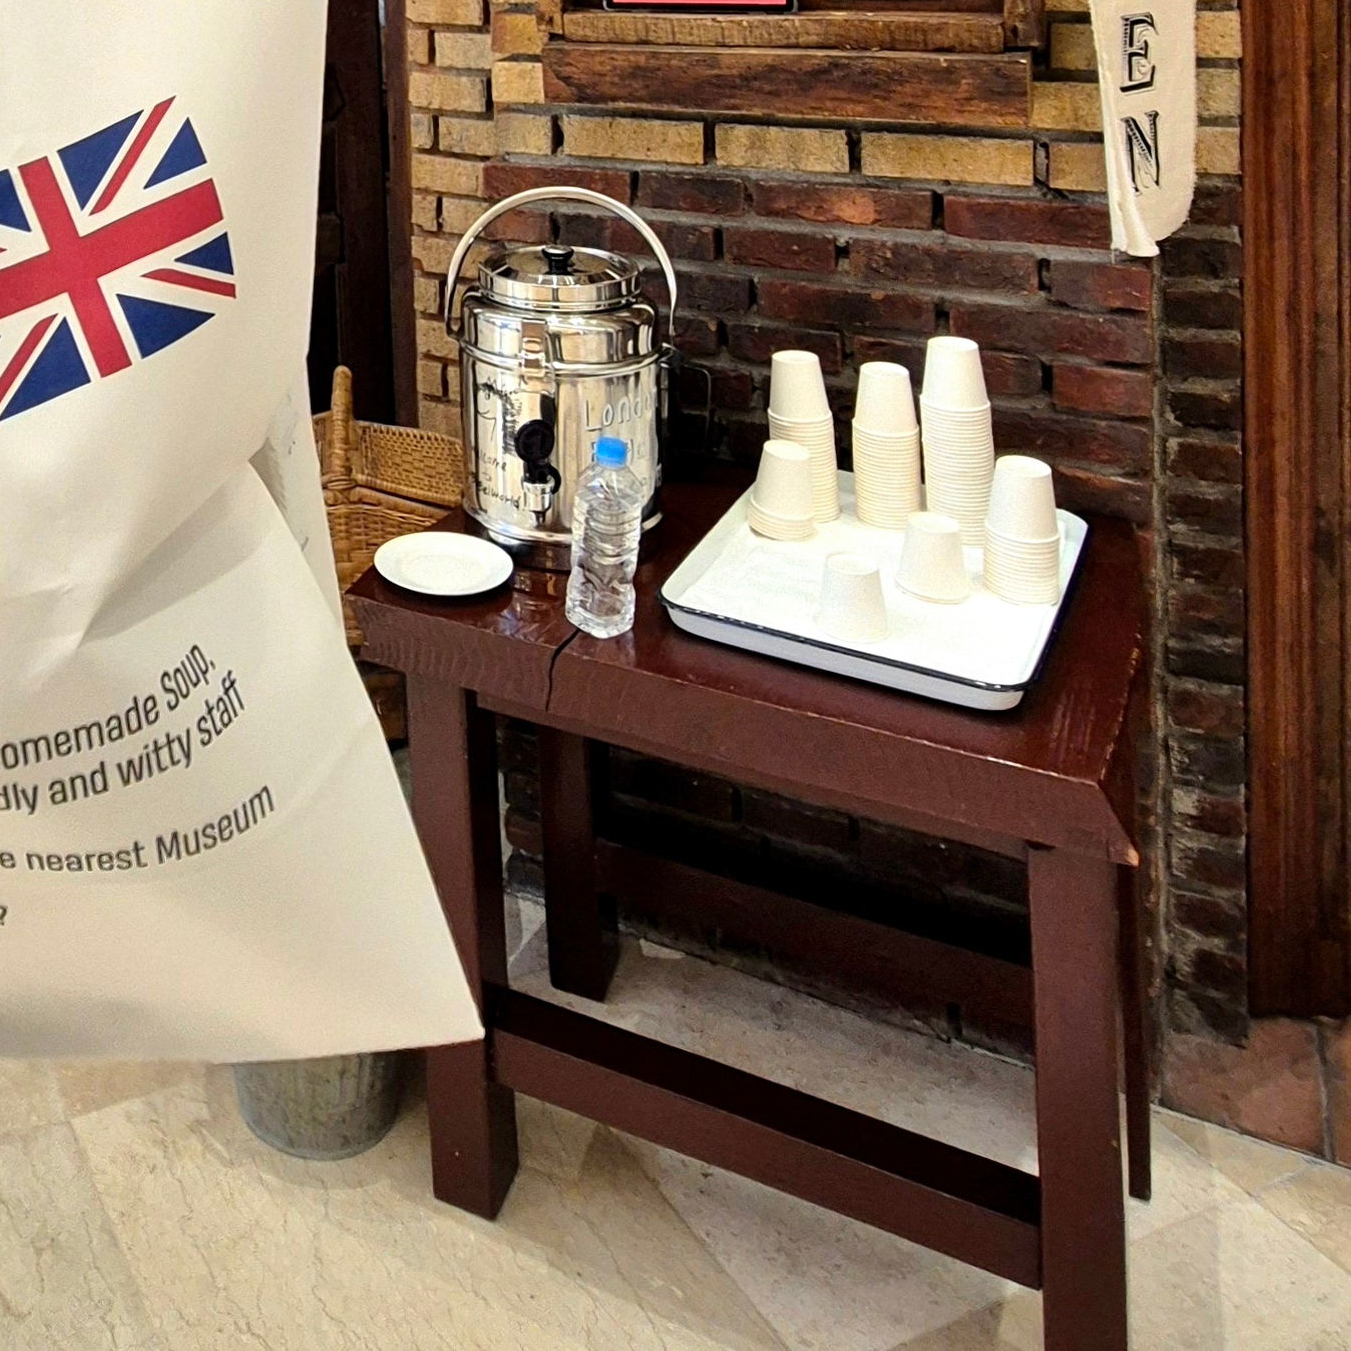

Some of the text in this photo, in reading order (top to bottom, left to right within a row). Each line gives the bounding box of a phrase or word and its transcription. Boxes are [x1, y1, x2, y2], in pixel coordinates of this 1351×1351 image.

[159, 644, 216, 711] Soup,
[49, 761, 109, 806] and
[116, 727, 193, 787] witty
[197, 670, 245, 747] staff
[26, 841, 148, 873] nearest
[155, 784, 275, 864] Museum
